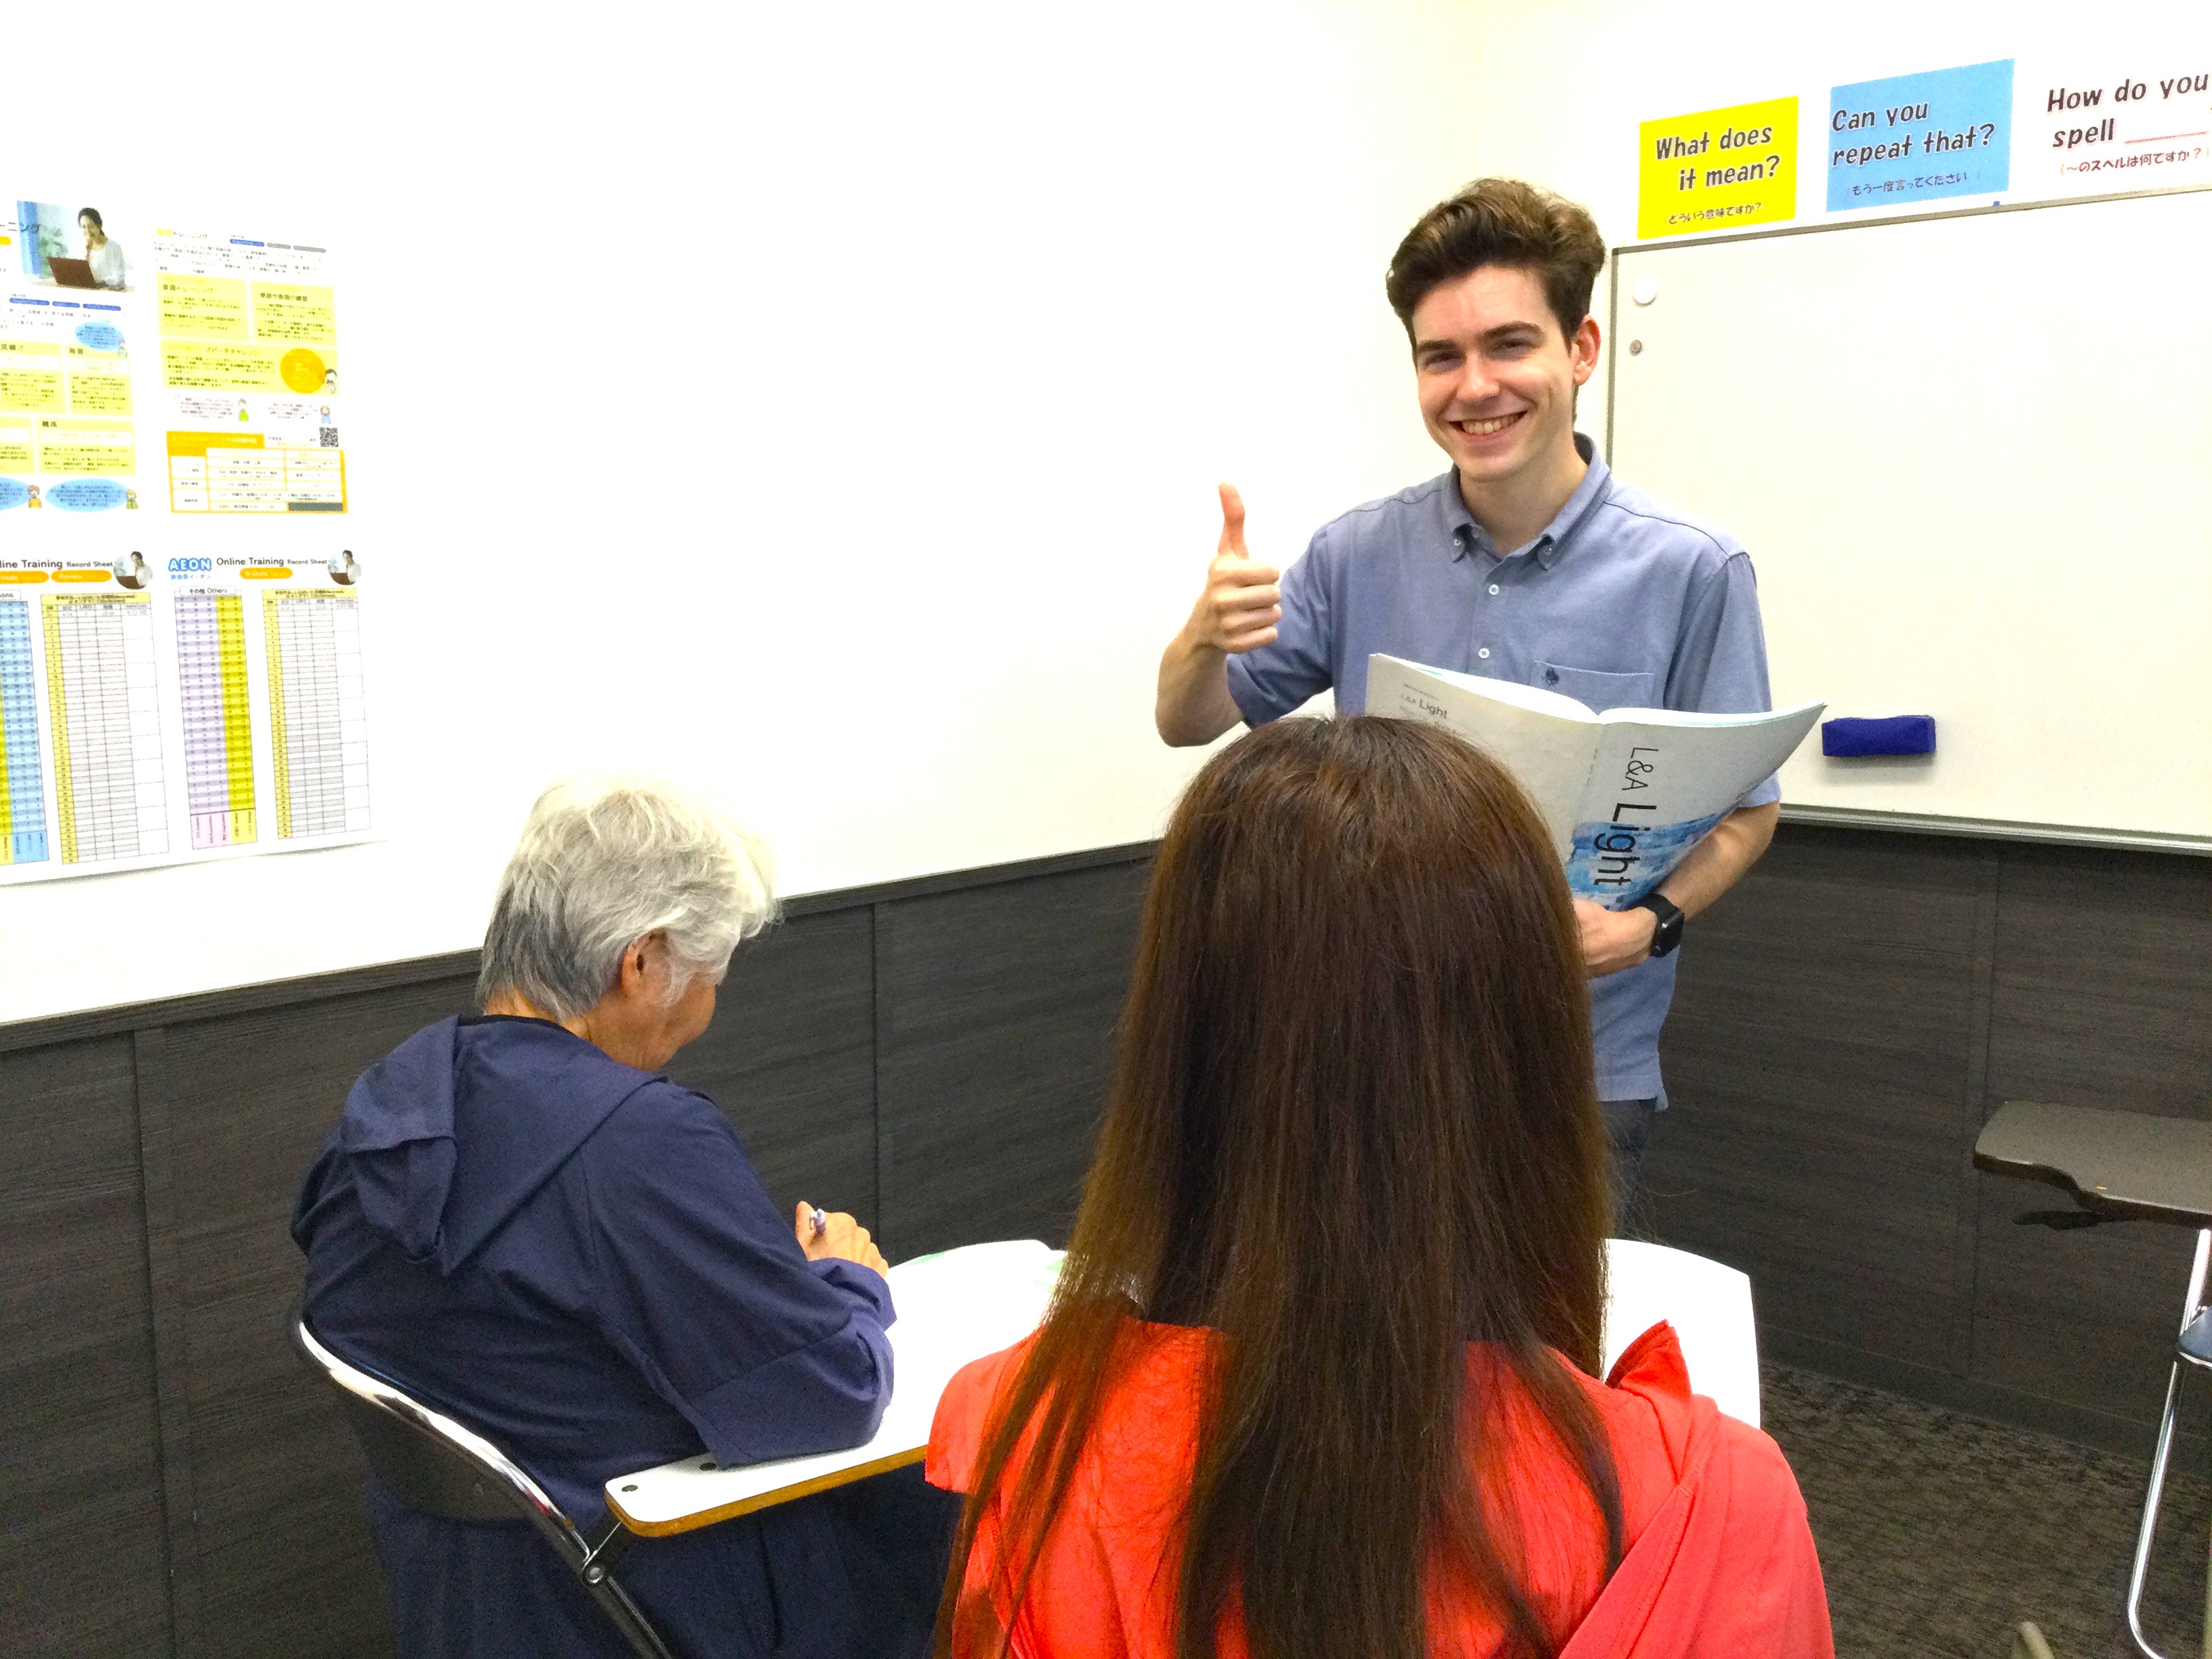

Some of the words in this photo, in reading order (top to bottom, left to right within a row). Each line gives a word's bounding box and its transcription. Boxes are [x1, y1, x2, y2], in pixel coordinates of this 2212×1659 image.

[2047, 87, 2103, 112] How
[2114, 78, 2147, 102] do
[2159, 73, 2209, 100] you
[1832, 109, 1875, 131] Can
[1886, 102, 1929, 127] you
[2052, 117, 2115, 149] spell
[1656, 131, 1710, 160] What
[1719, 127, 1772, 150] does
[1832, 134, 1912, 166] repeat
[1923, 123, 1995, 154] that?
[1679, 168, 1696, 190] it
[1705, 155, 1780, 187] mean?
[21, 559, 63, 570] Training
[168, 558, 212, 572] AEON
[216, 557, 246, 566] Online
[248, 557, 285, 567] Training
[1419, 699, 1448, 719] Light
[1621, 747, 1659, 791] L&A
[1593, 802, 1658, 886] Light
